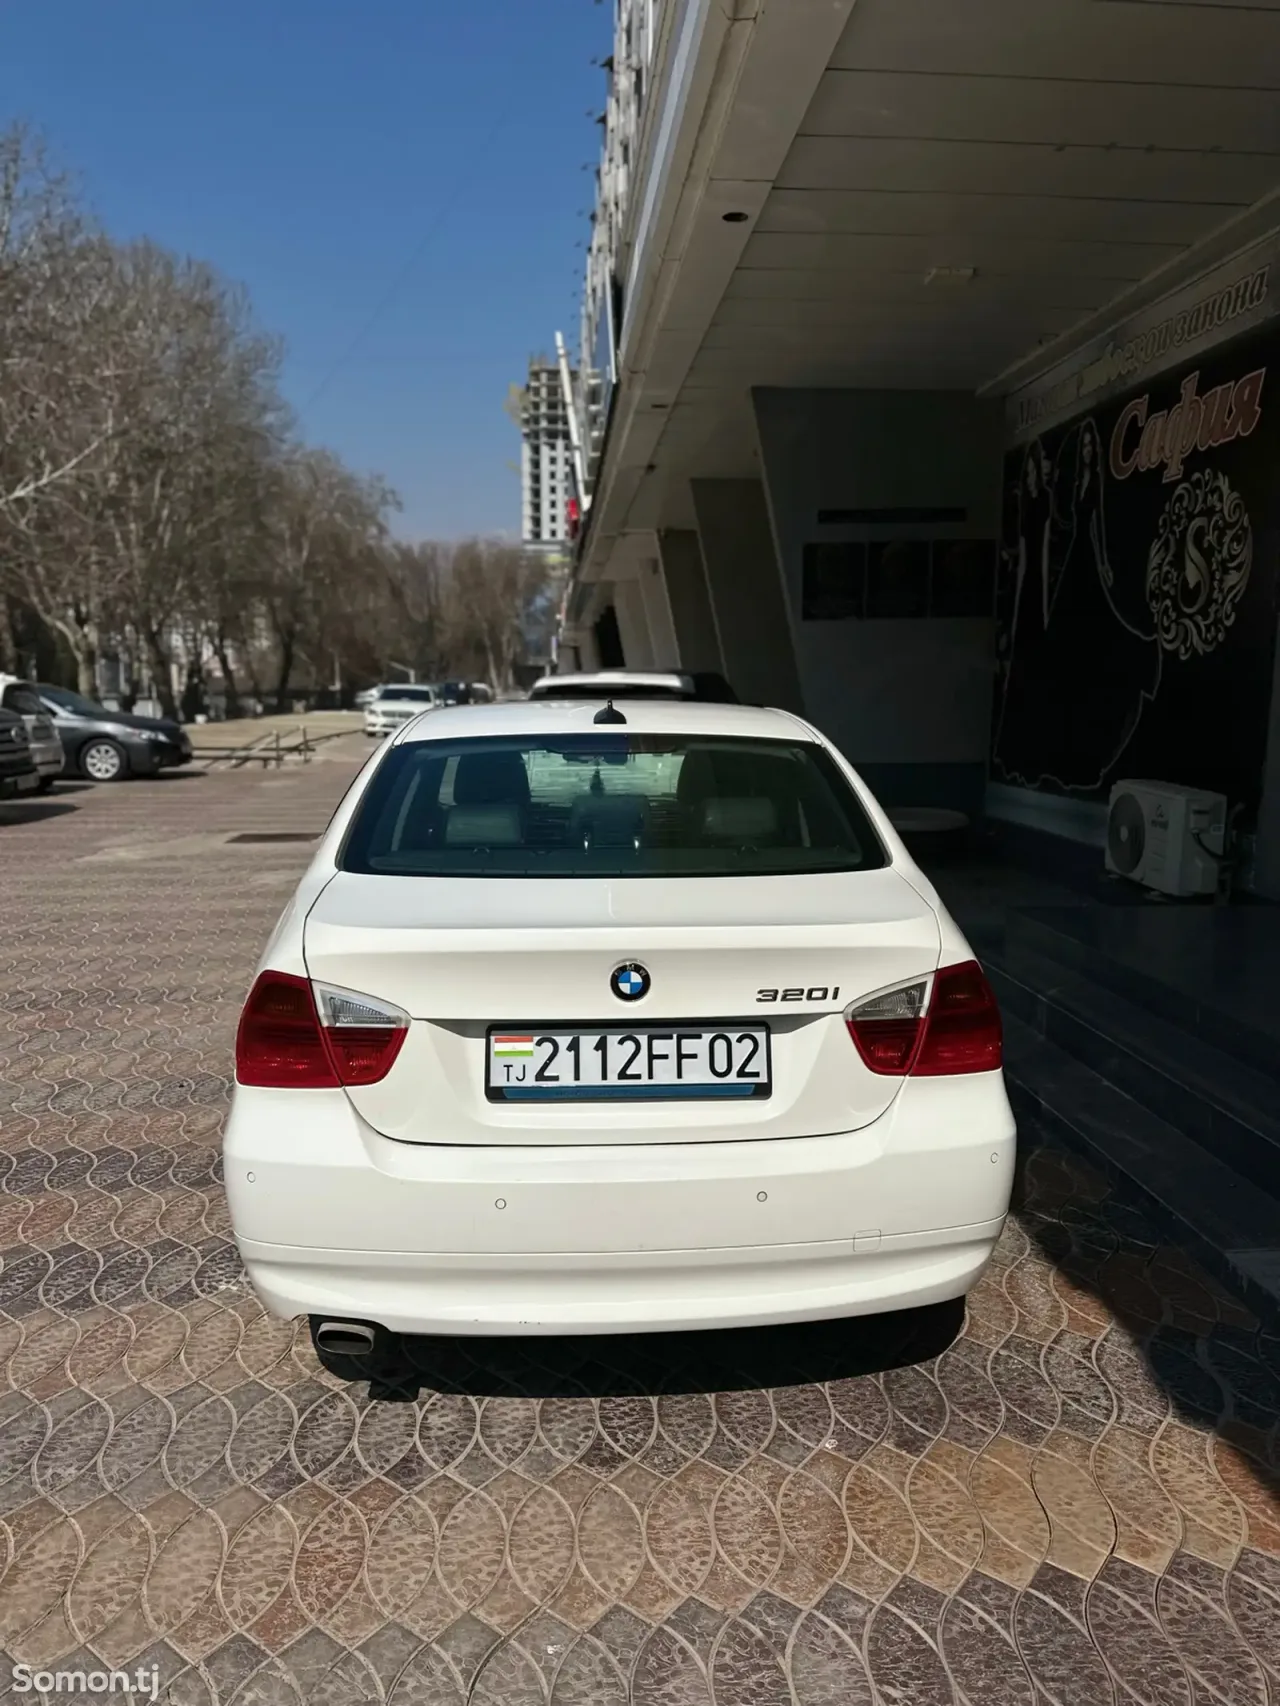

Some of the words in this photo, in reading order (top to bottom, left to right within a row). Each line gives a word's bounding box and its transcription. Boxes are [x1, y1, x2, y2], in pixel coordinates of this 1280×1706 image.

[1173, 264, 1271, 347] занона
[1109, 367, 1267, 483] Сафия
[503, 1064, 526, 1083] TJ
[534, 1033, 760, 1082] 2112FF02
